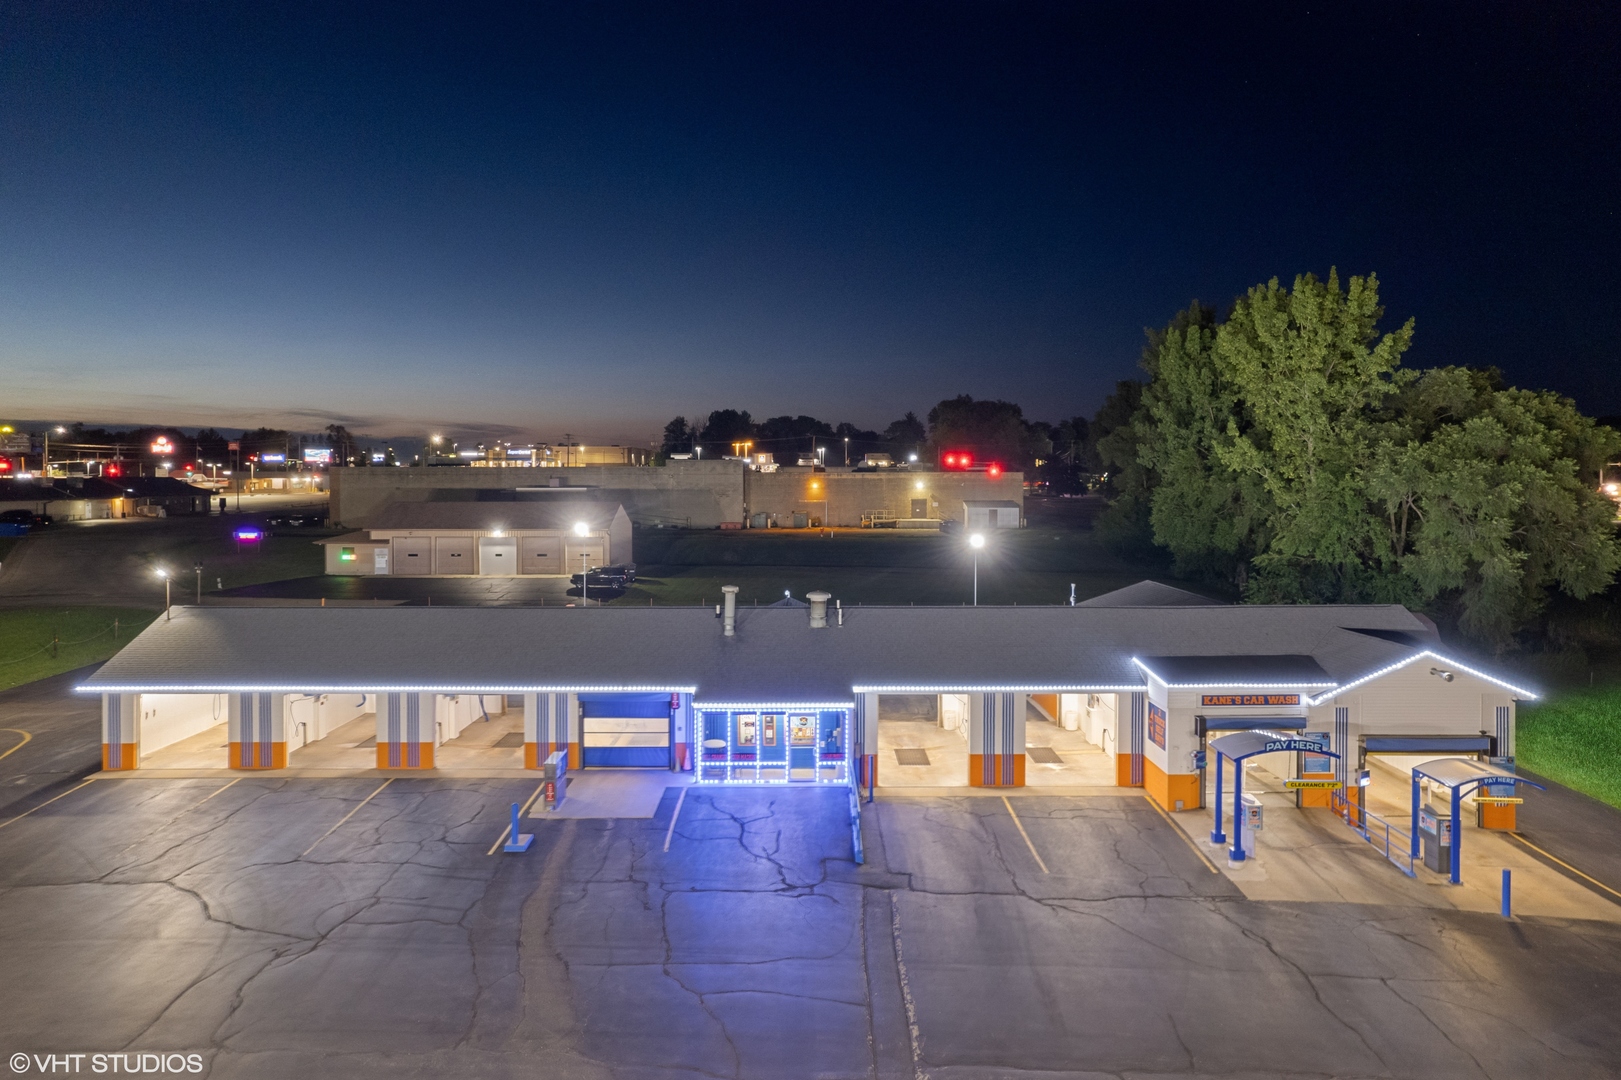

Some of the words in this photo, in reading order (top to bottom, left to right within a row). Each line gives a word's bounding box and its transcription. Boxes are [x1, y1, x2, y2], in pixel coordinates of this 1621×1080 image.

[1203, 696, 1242, 705] KANE'S
[1243, 695, 1265, 705] CAR
[1267, 695, 1299, 704] WASH
[1266, 740, 1289, 752] PAY
[1291, 741, 1322, 753] HERE
[1483, 777, 1497, 785] PAY
[1497, 777, 1516, 785] HERE
